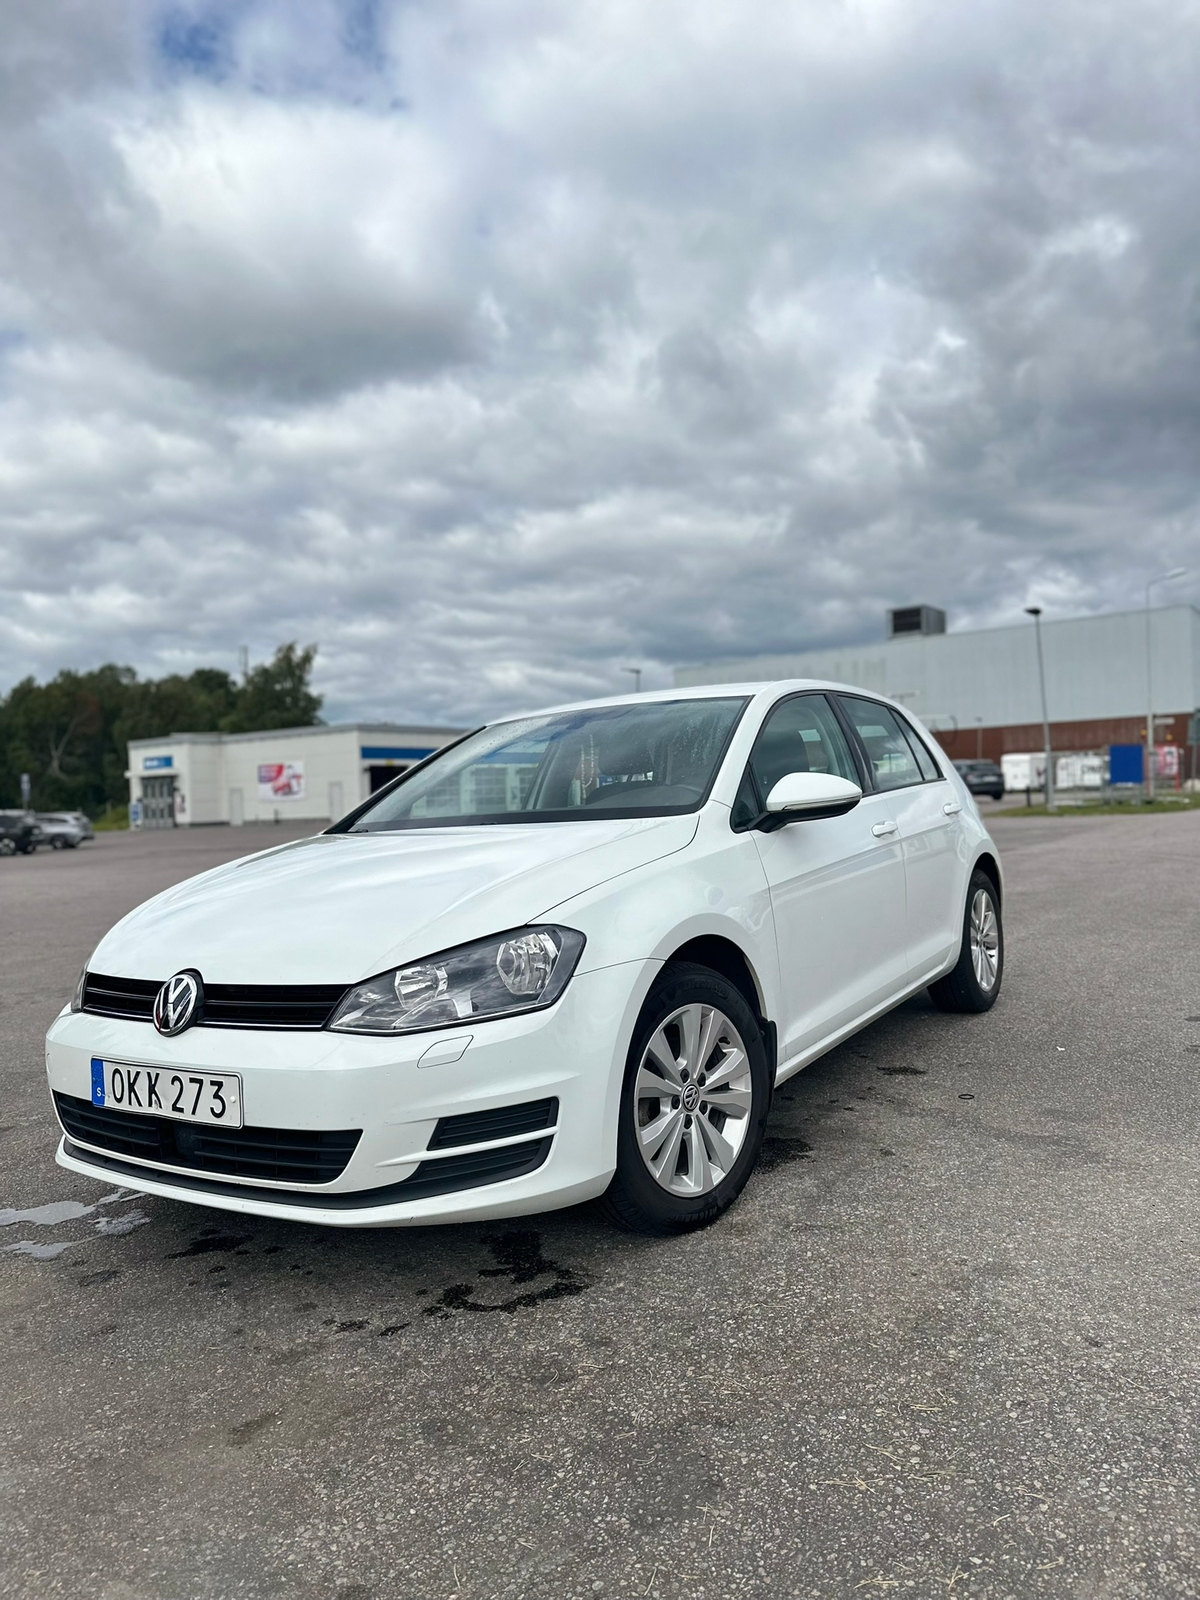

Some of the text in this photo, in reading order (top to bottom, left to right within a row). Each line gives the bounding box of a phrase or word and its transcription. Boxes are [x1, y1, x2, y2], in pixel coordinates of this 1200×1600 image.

[96, 1087, 102, 1097] S
[111, 1067, 227, 1119] OKK 273
